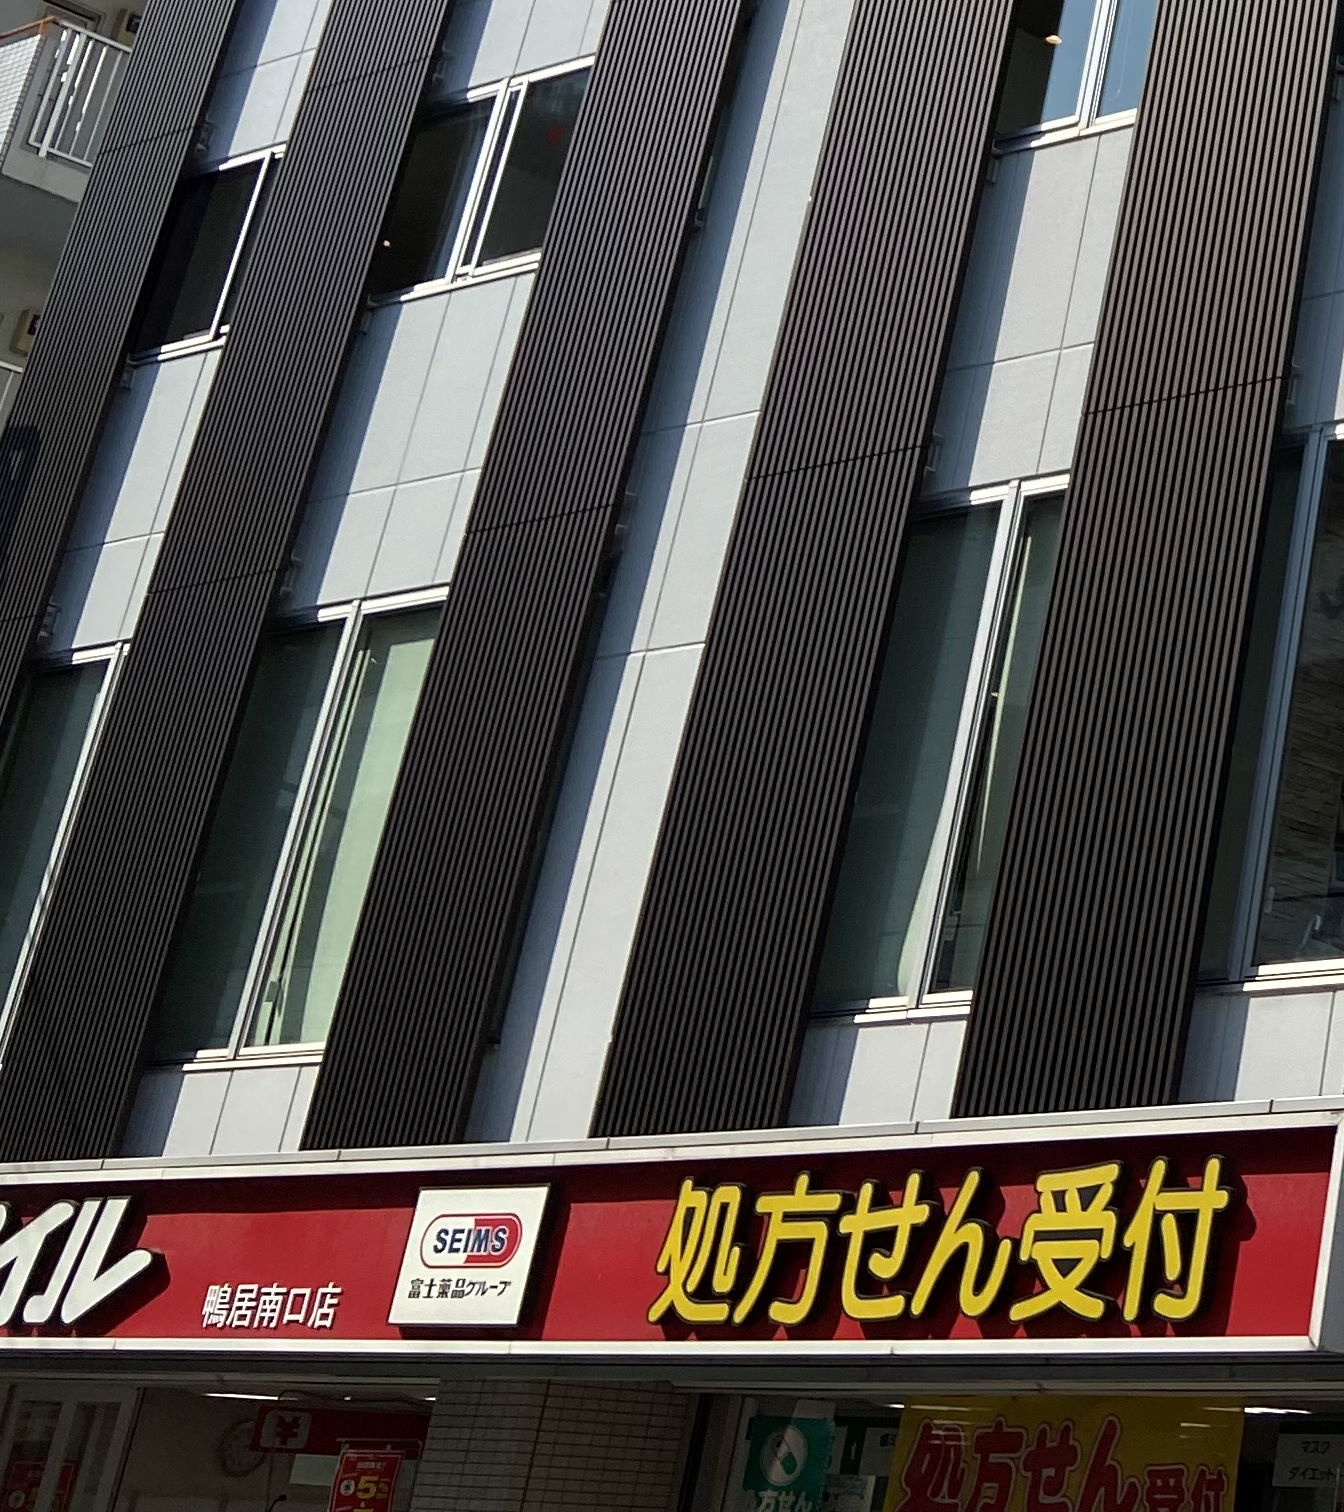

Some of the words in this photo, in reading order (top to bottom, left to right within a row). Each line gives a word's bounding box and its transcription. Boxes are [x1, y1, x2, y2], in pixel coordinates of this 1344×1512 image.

[432, 1226, 508, 1255] SEIMS
[648, 1154, 1229, 1325] 処方せん受付
[202, 1282, 342, 1329] 鴨居南口店
